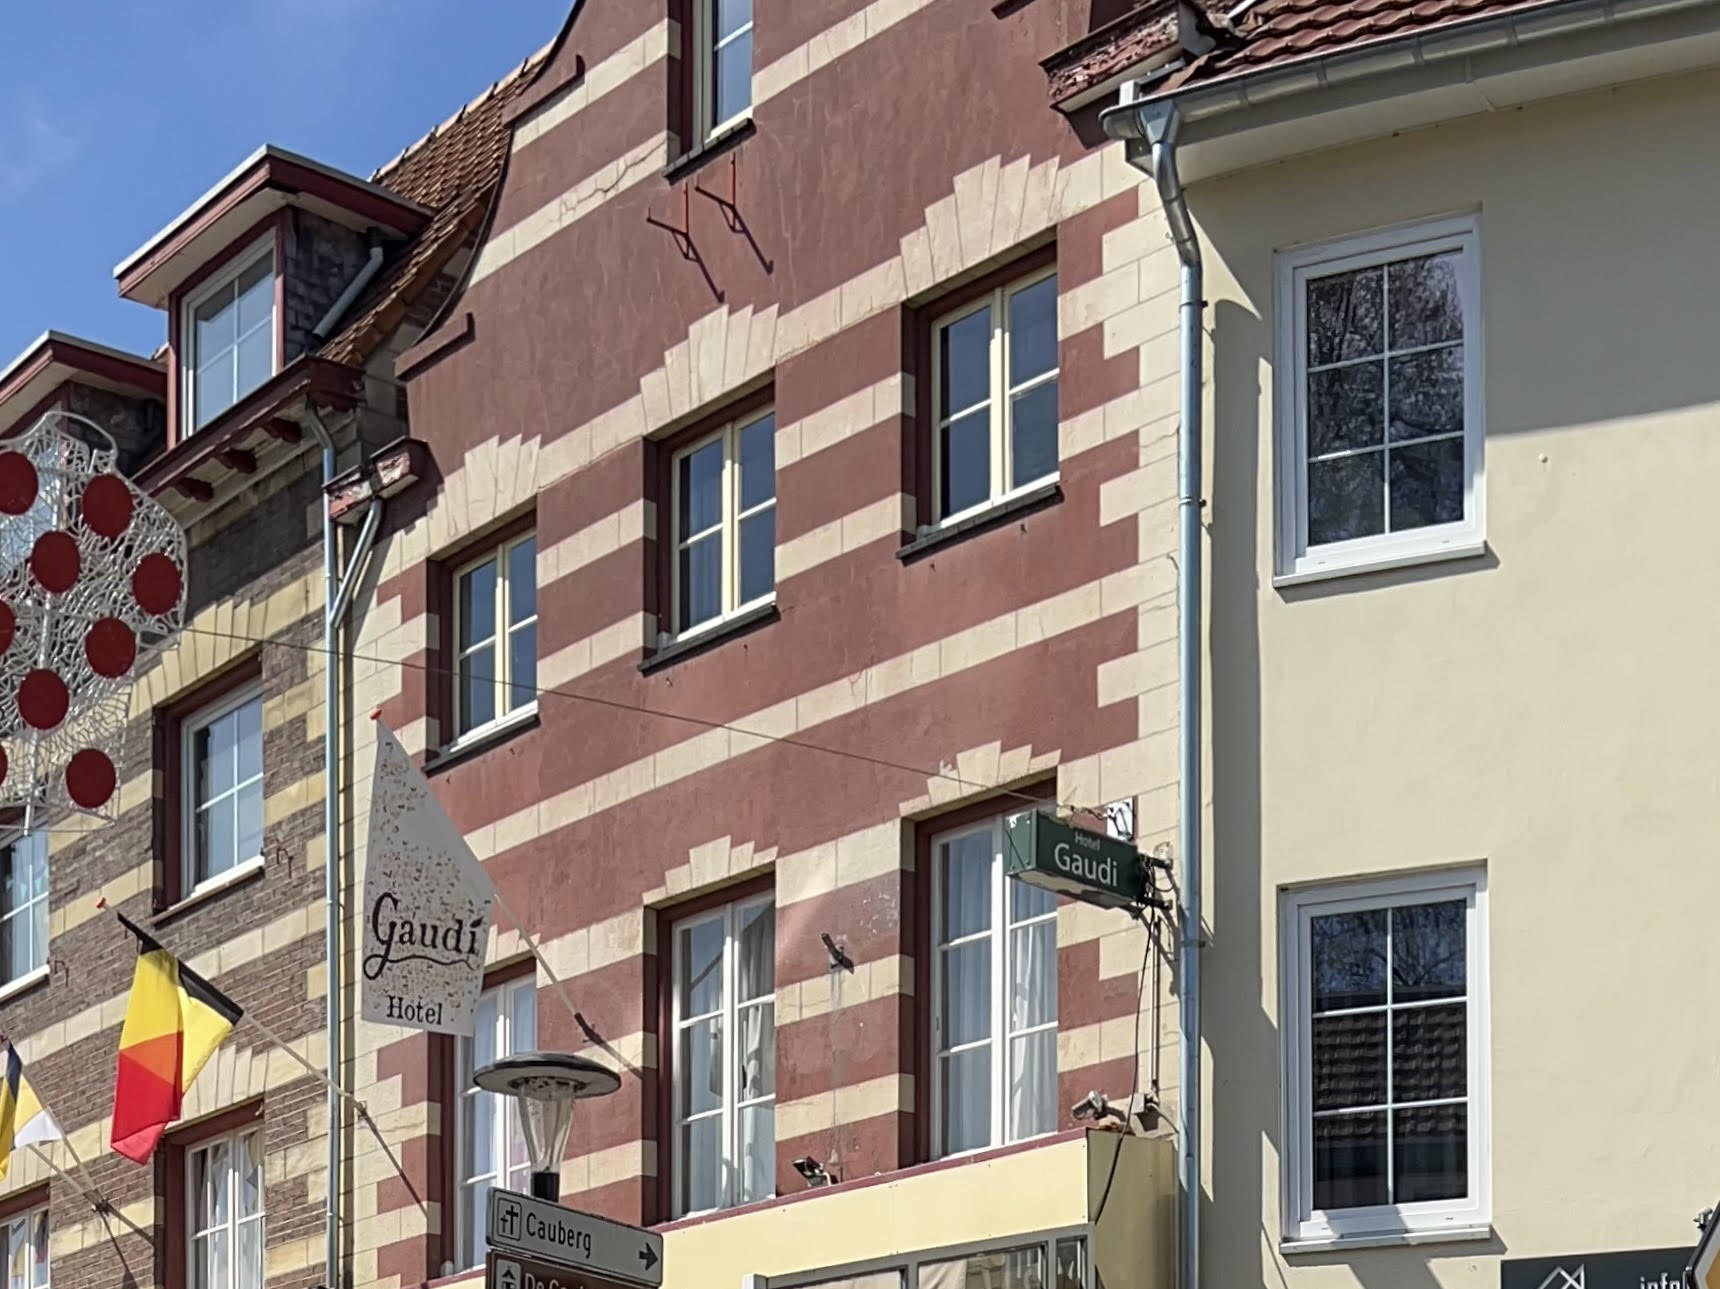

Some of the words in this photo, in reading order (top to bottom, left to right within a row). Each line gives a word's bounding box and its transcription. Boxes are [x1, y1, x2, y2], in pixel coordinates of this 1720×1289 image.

[1075, 832, 1101, 850] Hotel
[1054, 843, 1117, 886] Gaudi
[387, 995, 443, 1026] Hotel
[526, 1212, 591, 1258] Cauberg
